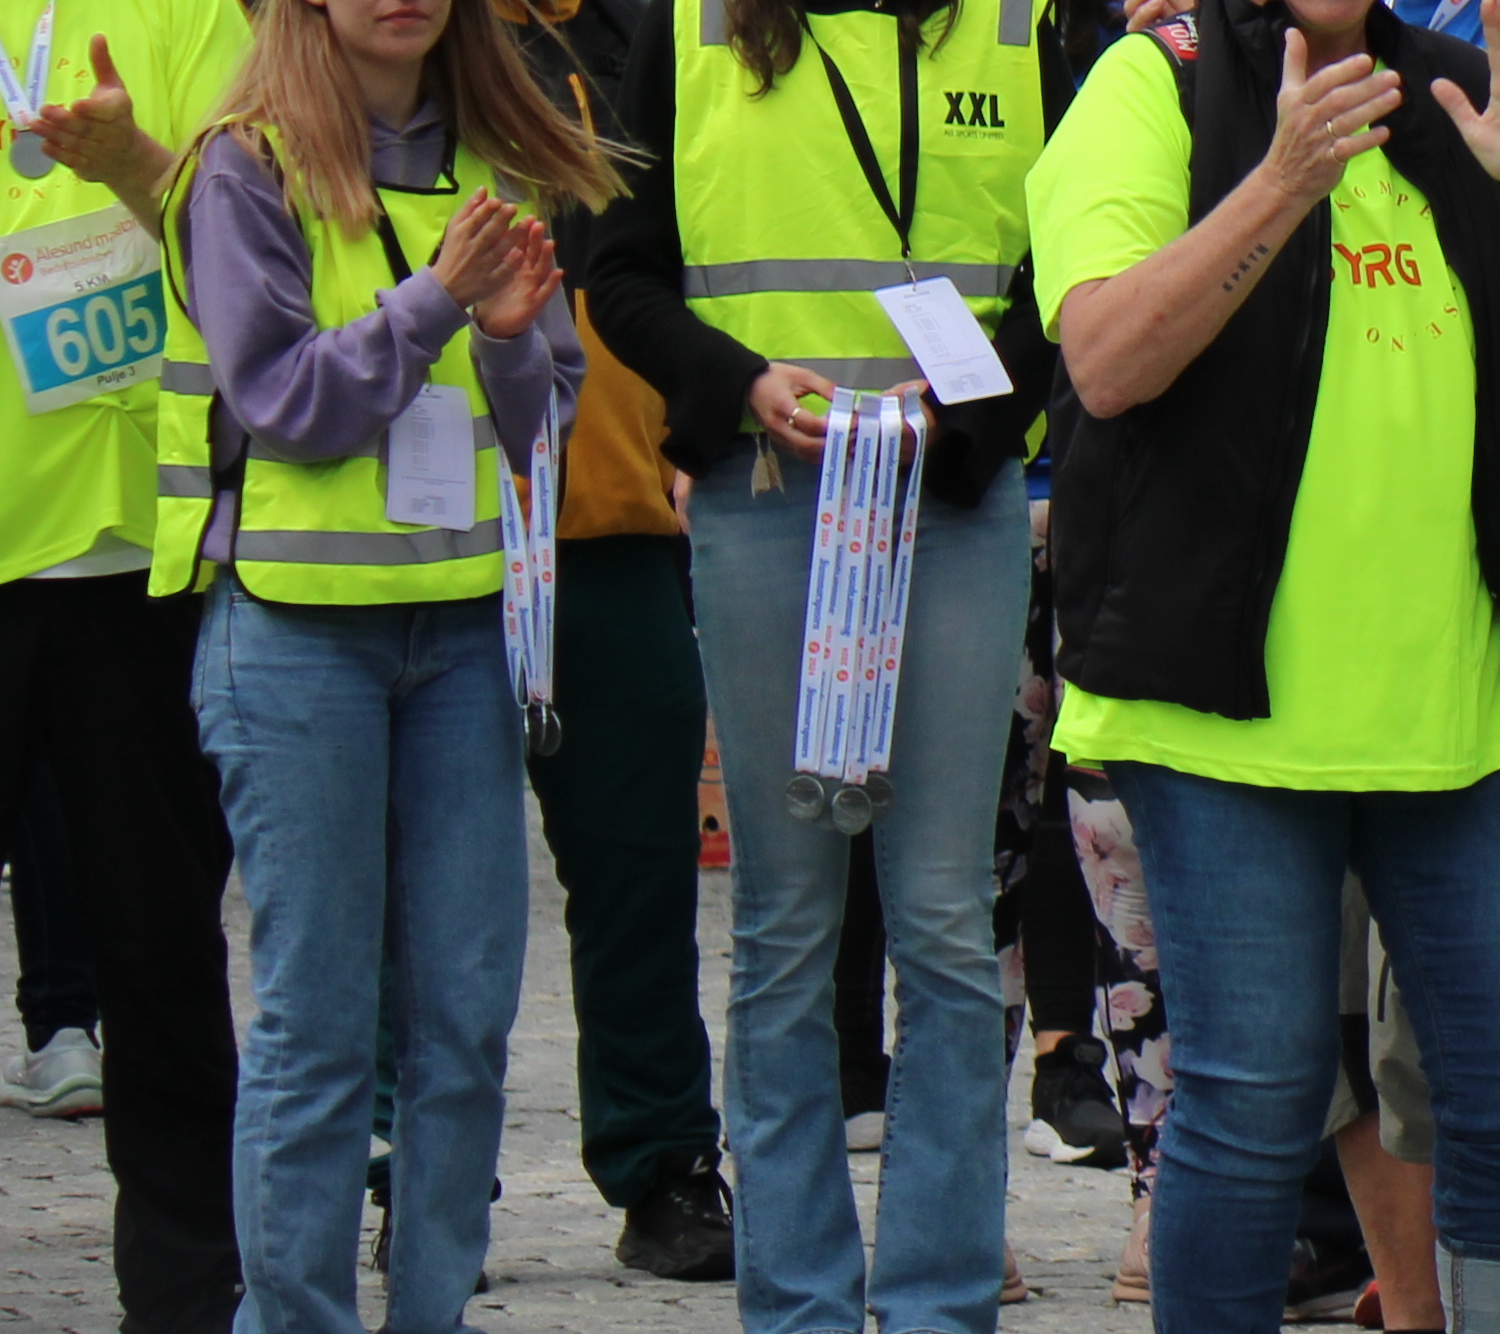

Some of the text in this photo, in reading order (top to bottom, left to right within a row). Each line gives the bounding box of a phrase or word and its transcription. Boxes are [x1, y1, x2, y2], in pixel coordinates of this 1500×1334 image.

[945, 92, 1005, 128] XXL
[74, 273, 111, 292] 5 KM
[1331, 244, 1422, 288] YRG
[46, 284, 158, 376] 605
[97, 365, 137, 386] Pulje 3
